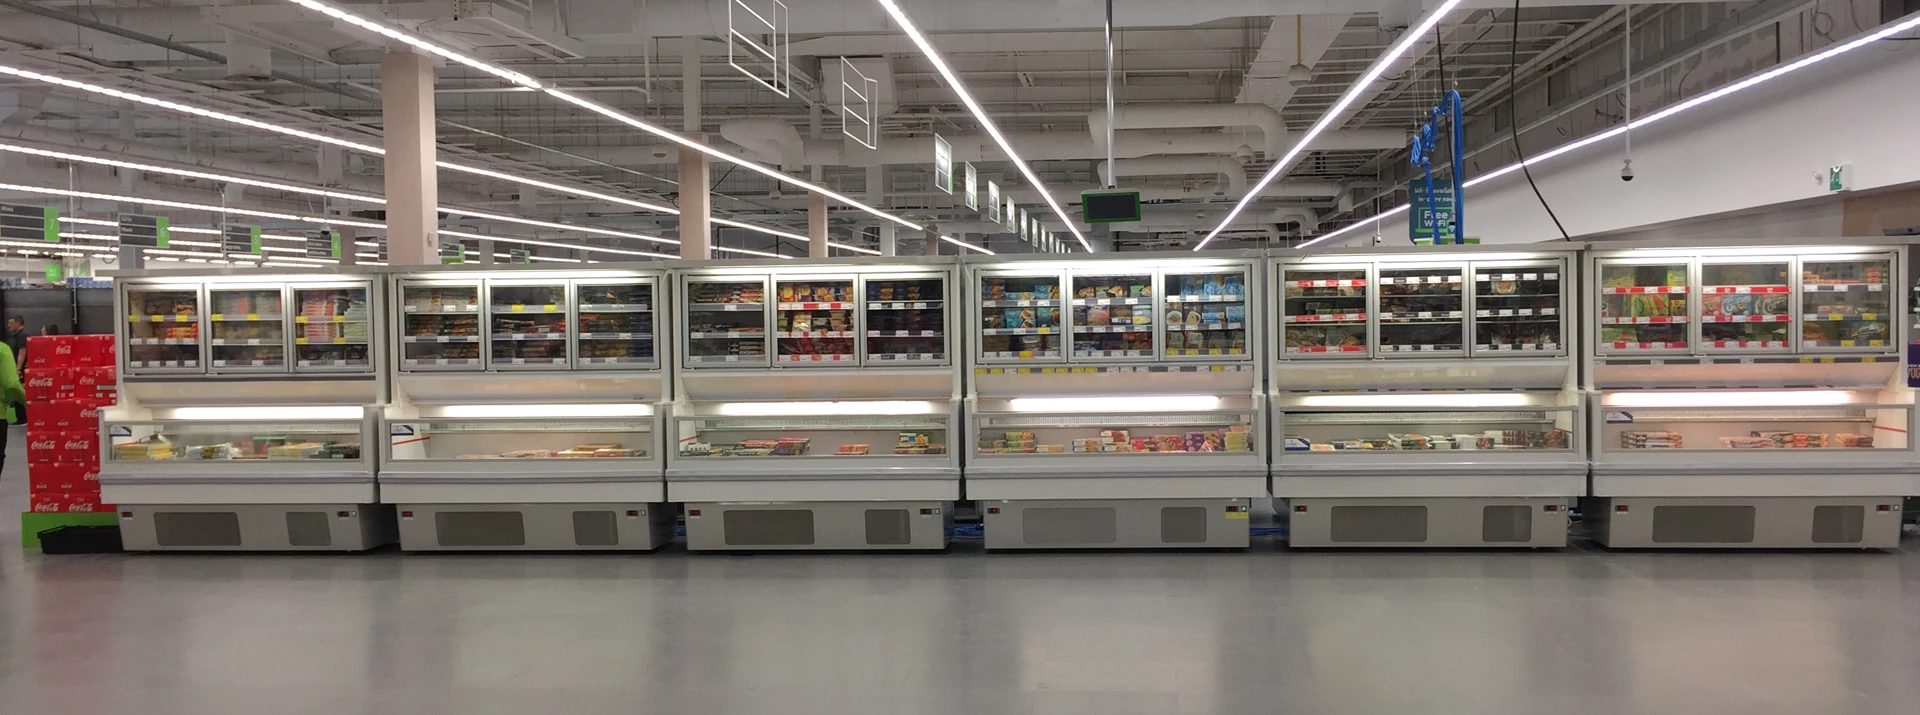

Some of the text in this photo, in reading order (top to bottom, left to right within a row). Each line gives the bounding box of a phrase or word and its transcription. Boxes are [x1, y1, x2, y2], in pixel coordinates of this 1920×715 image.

[49, 218, 55, 231] 7
[160, 227, 166, 238] 6
[334, 241, 339, 250] 4
